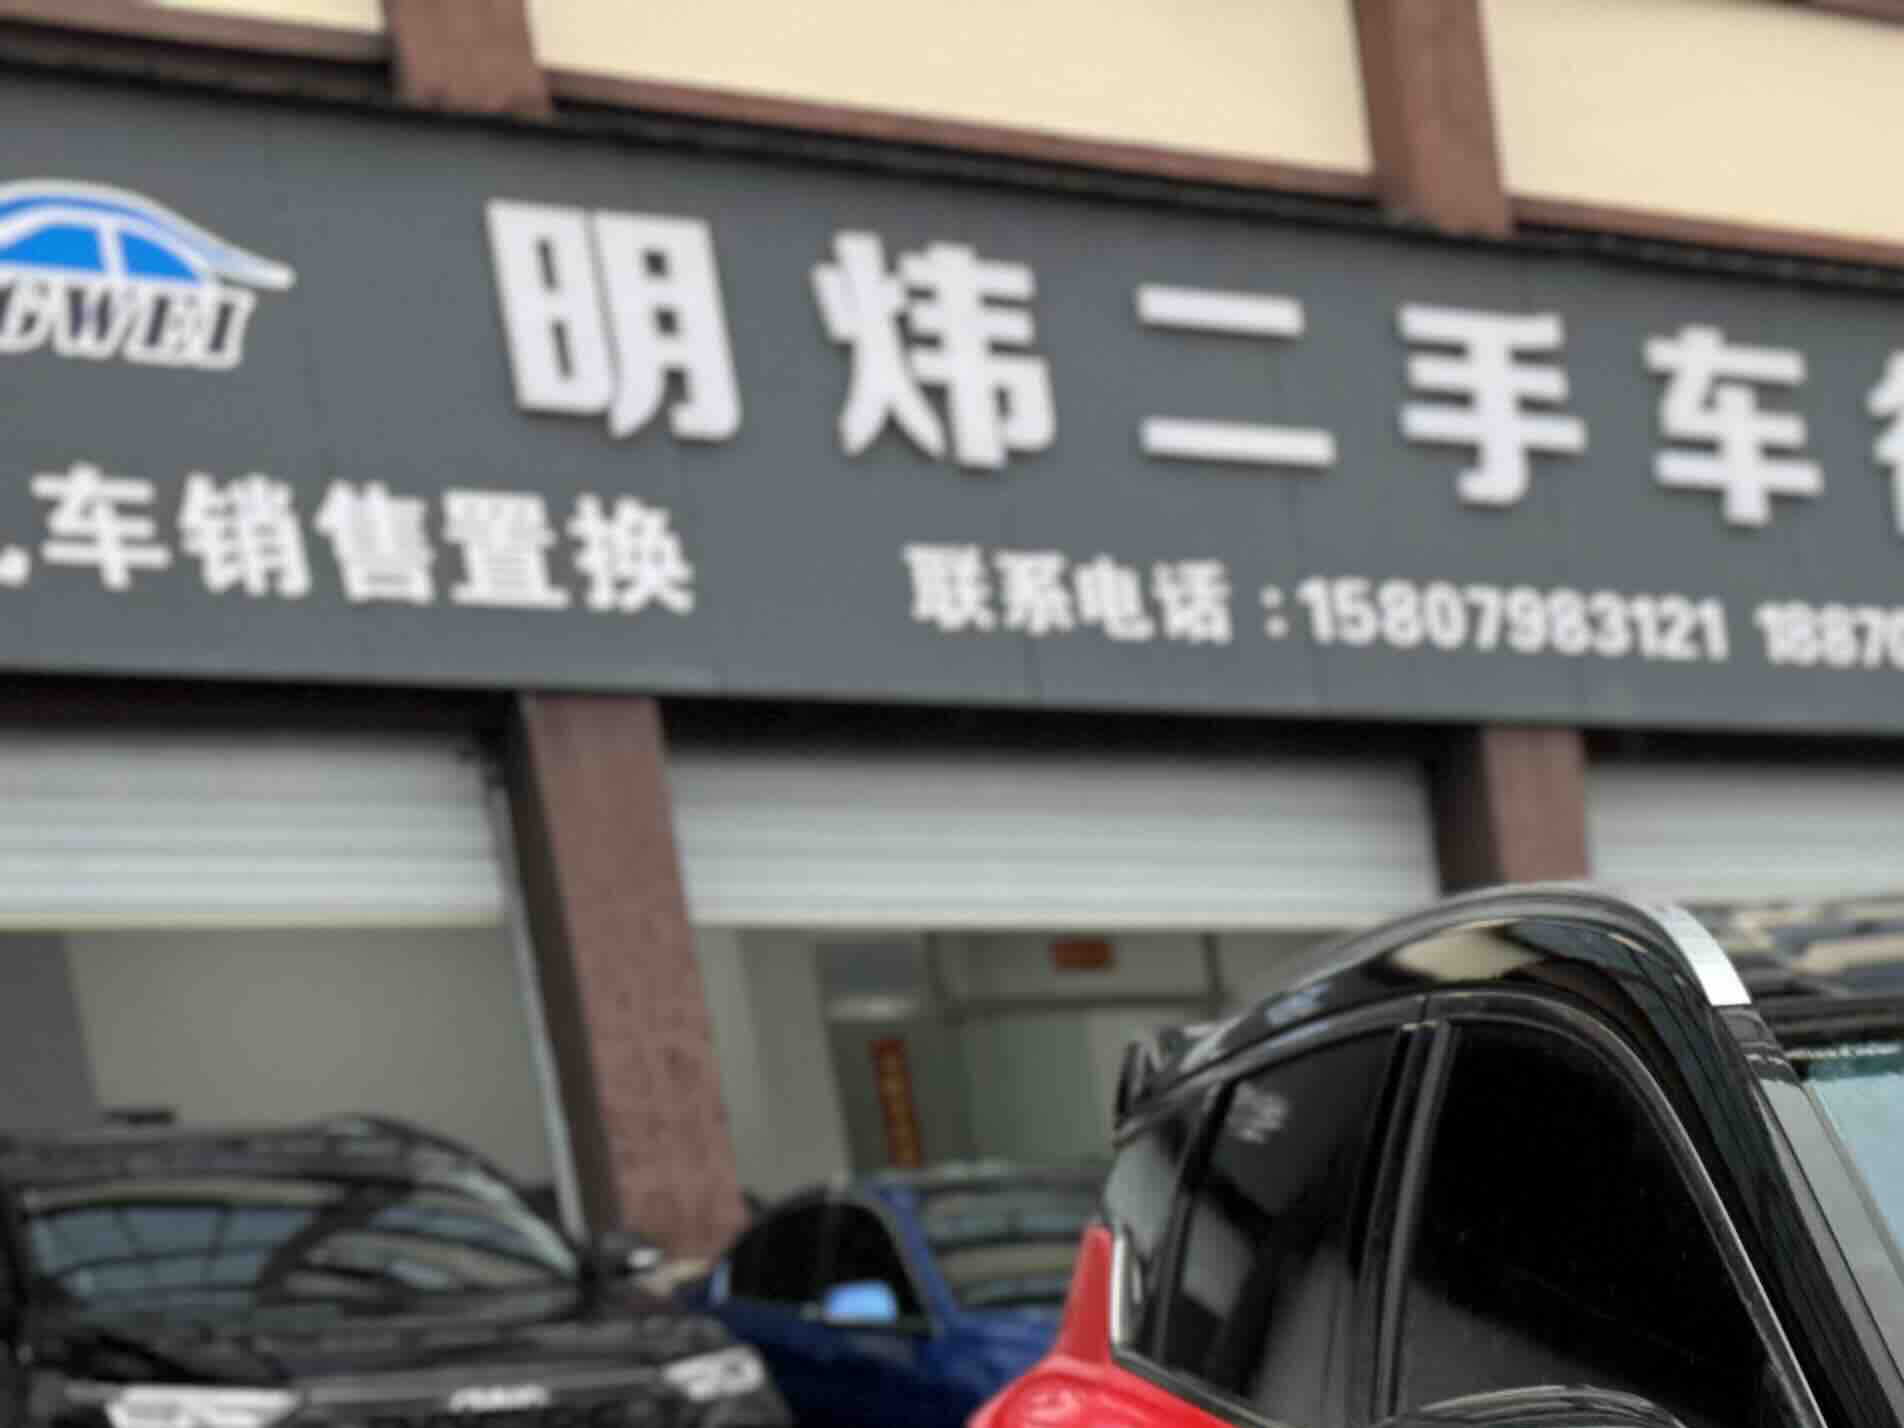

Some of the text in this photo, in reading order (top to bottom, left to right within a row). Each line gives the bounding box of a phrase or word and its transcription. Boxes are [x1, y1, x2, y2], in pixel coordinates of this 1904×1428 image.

[0, 279, 255, 369] GWEI
[0, 463, 696, 615] 车销售置换
[903, 543, 1233, 645] 联系电话
